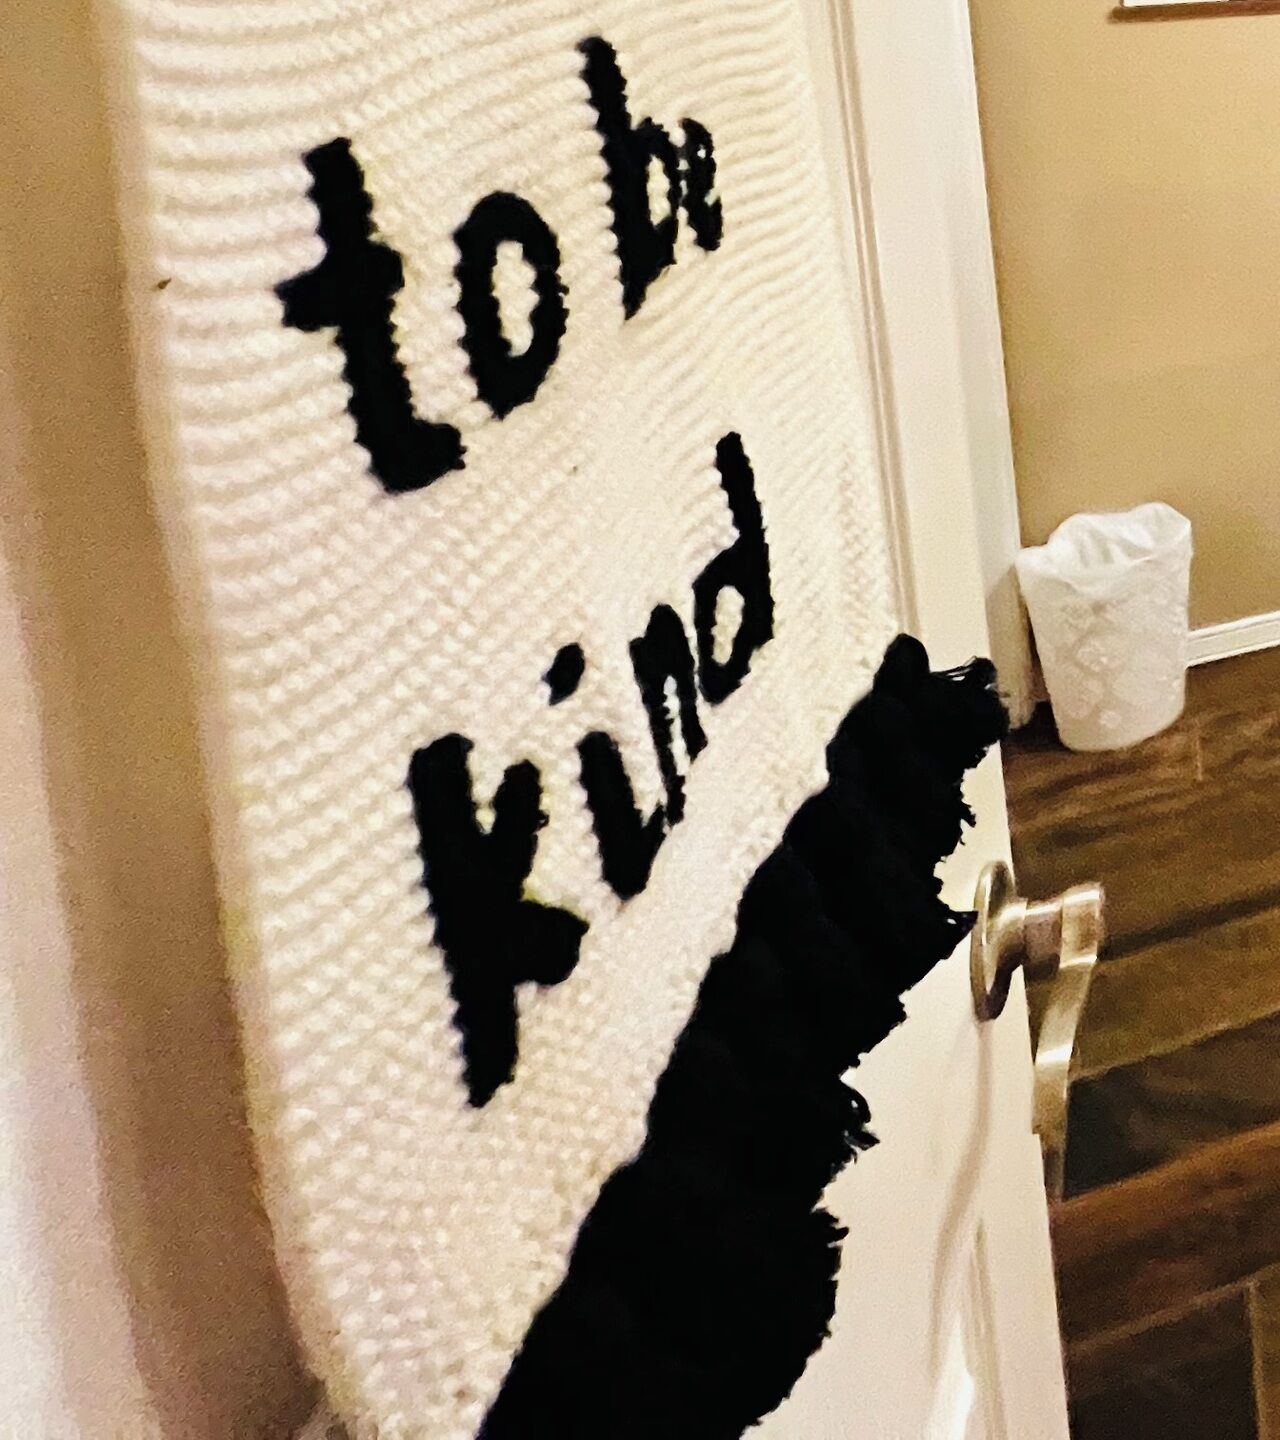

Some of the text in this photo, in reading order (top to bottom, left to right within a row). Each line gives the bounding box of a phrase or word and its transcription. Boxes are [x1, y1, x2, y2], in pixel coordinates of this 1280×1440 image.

[275, 36, 722, 494] to be
[409, 430, 775, 1109] kind
